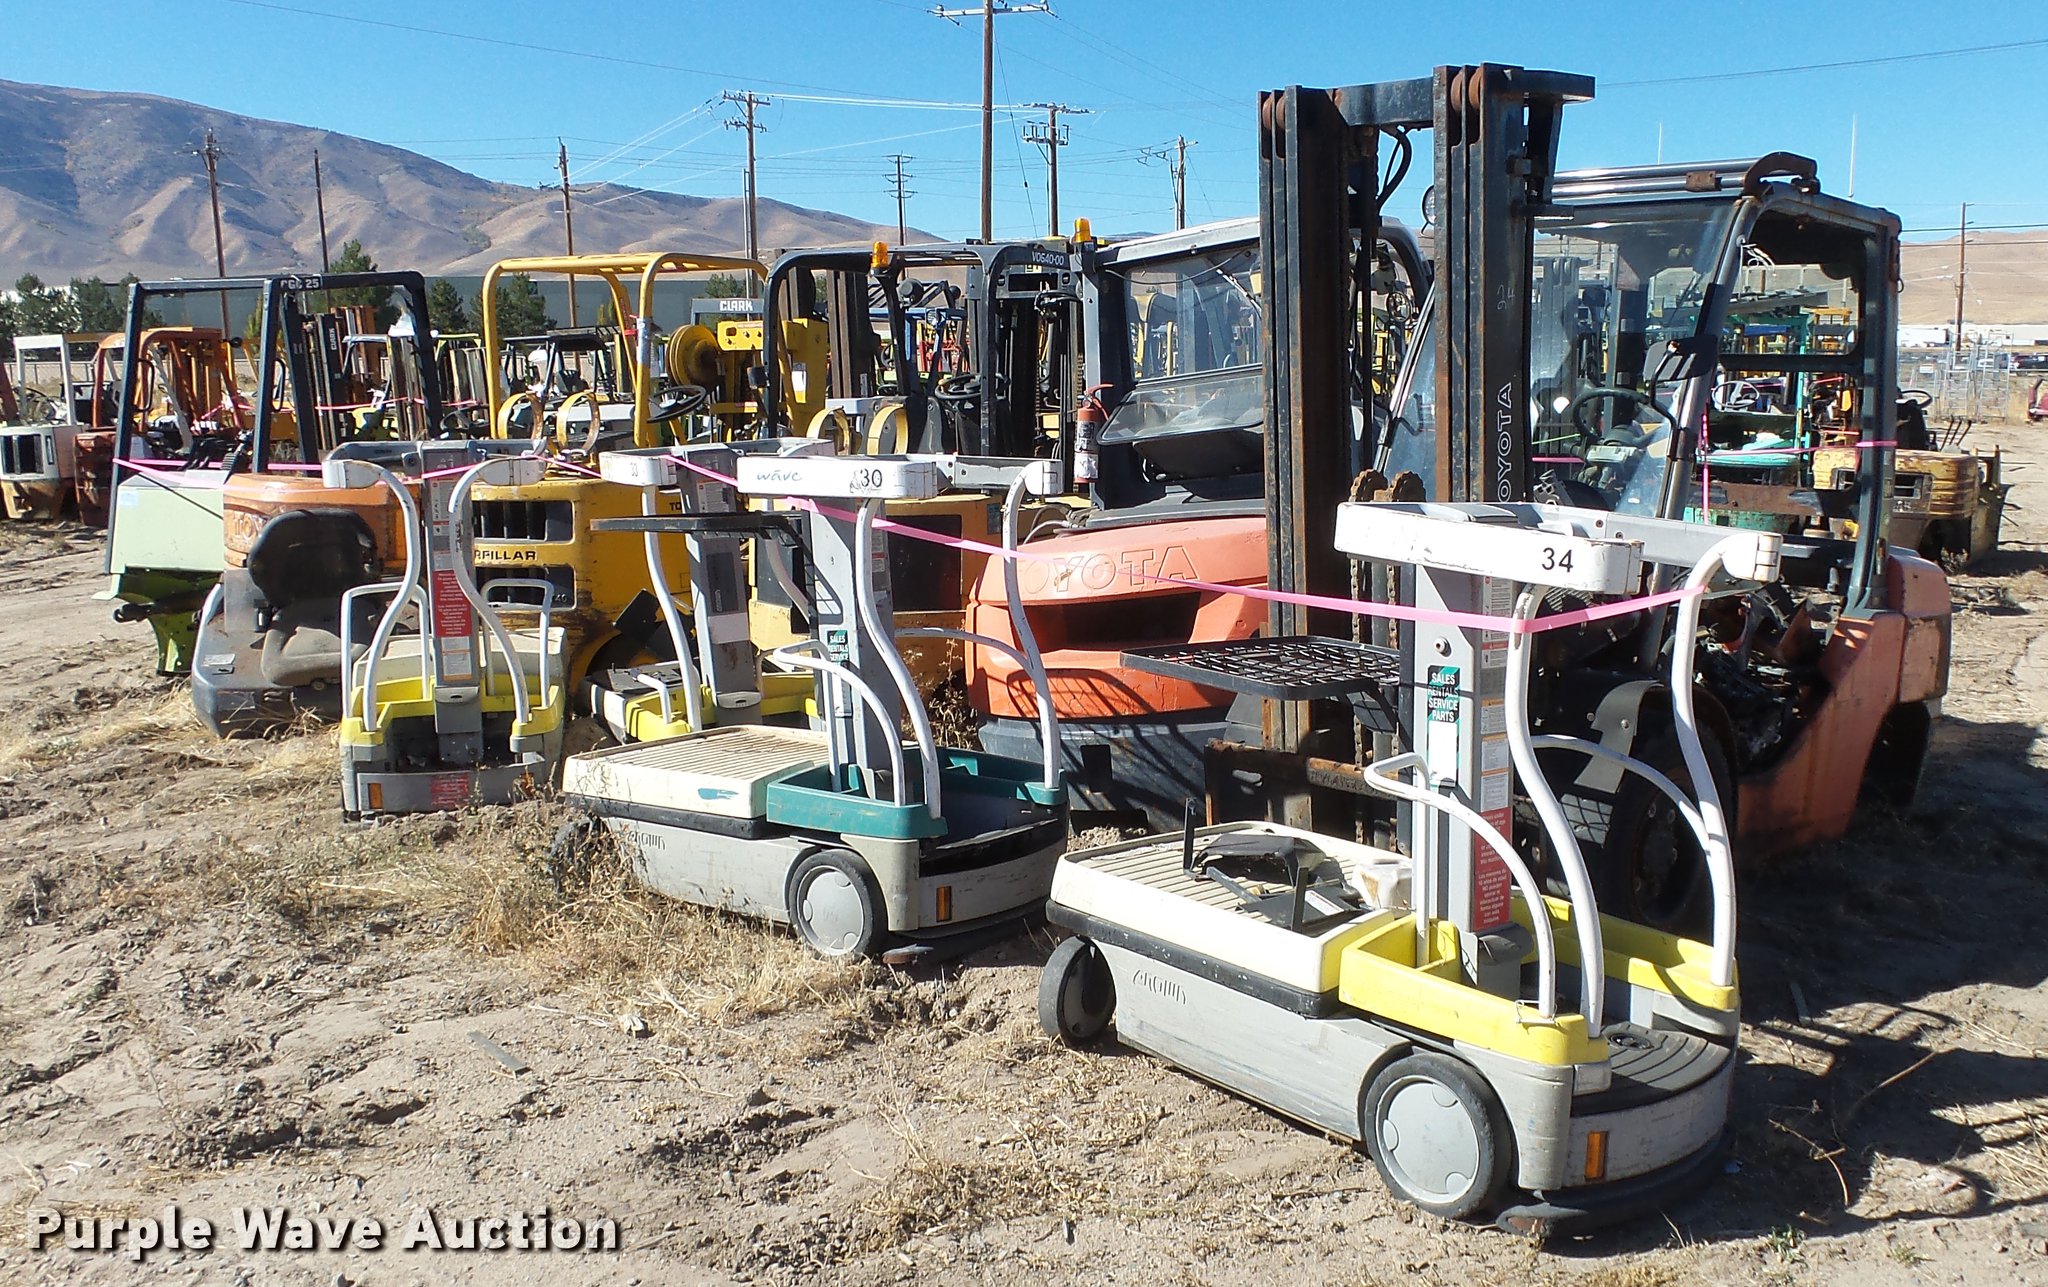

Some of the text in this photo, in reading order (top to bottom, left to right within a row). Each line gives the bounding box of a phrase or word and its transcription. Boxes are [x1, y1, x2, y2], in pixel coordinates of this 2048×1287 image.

[305, 278, 319, 288] 25
[720, 300, 753, 311] CLARK
[860, 468, 883, 488] 30
[1541, 547, 1573, 573] 34
[1431, 672, 1455, 685] SALES
[1428, 686, 1458, 697] RENTALS
[1428, 698, 1458, 710] SERVICE
[1432, 710, 1454, 722] PARTS
